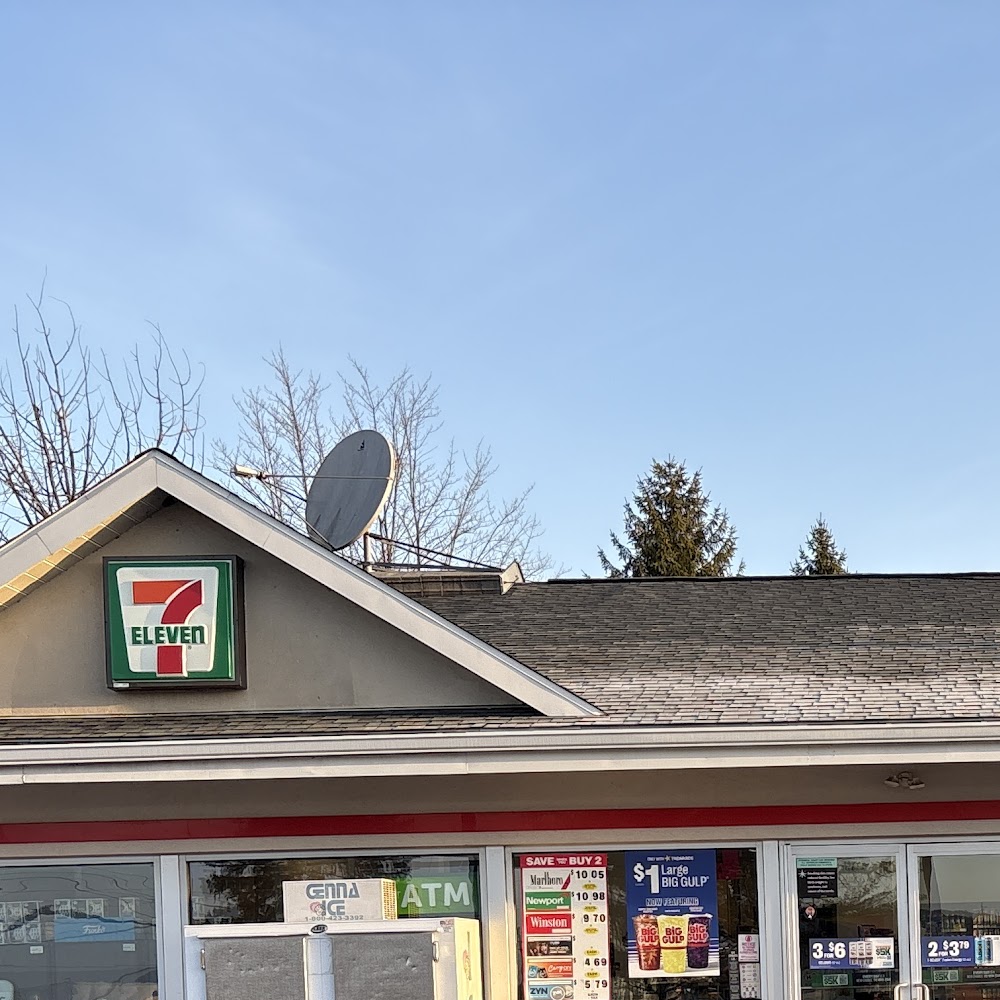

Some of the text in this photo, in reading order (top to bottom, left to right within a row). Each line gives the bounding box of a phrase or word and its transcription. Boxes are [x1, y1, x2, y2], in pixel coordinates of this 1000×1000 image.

[132, 579, 203, 675] 7
[526, 856, 555, 866] SAVE
[569, 856, 592, 865] BUY
[594, 856, 603, 865] 2
[661, 864, 689, 877] Large
[530, 871, 564, 886] Marlboro
[633, 862, 660, 894] $1
[661, 876, 679, 888] BIG
[401, 882, 470, 908] ATM
[526, 896, 564, 906] Newport
[645, 897, 699, 906] NOW FEATURING
[530, 916, 568, 928] Winston
[662, 936, 685, 944] GULP
[688, 933, 708, 941] GULP
[812, 942, 823, 959] 3
[928, 941, 938, 957] 2
[530, 987, 548, 995] ZYN
